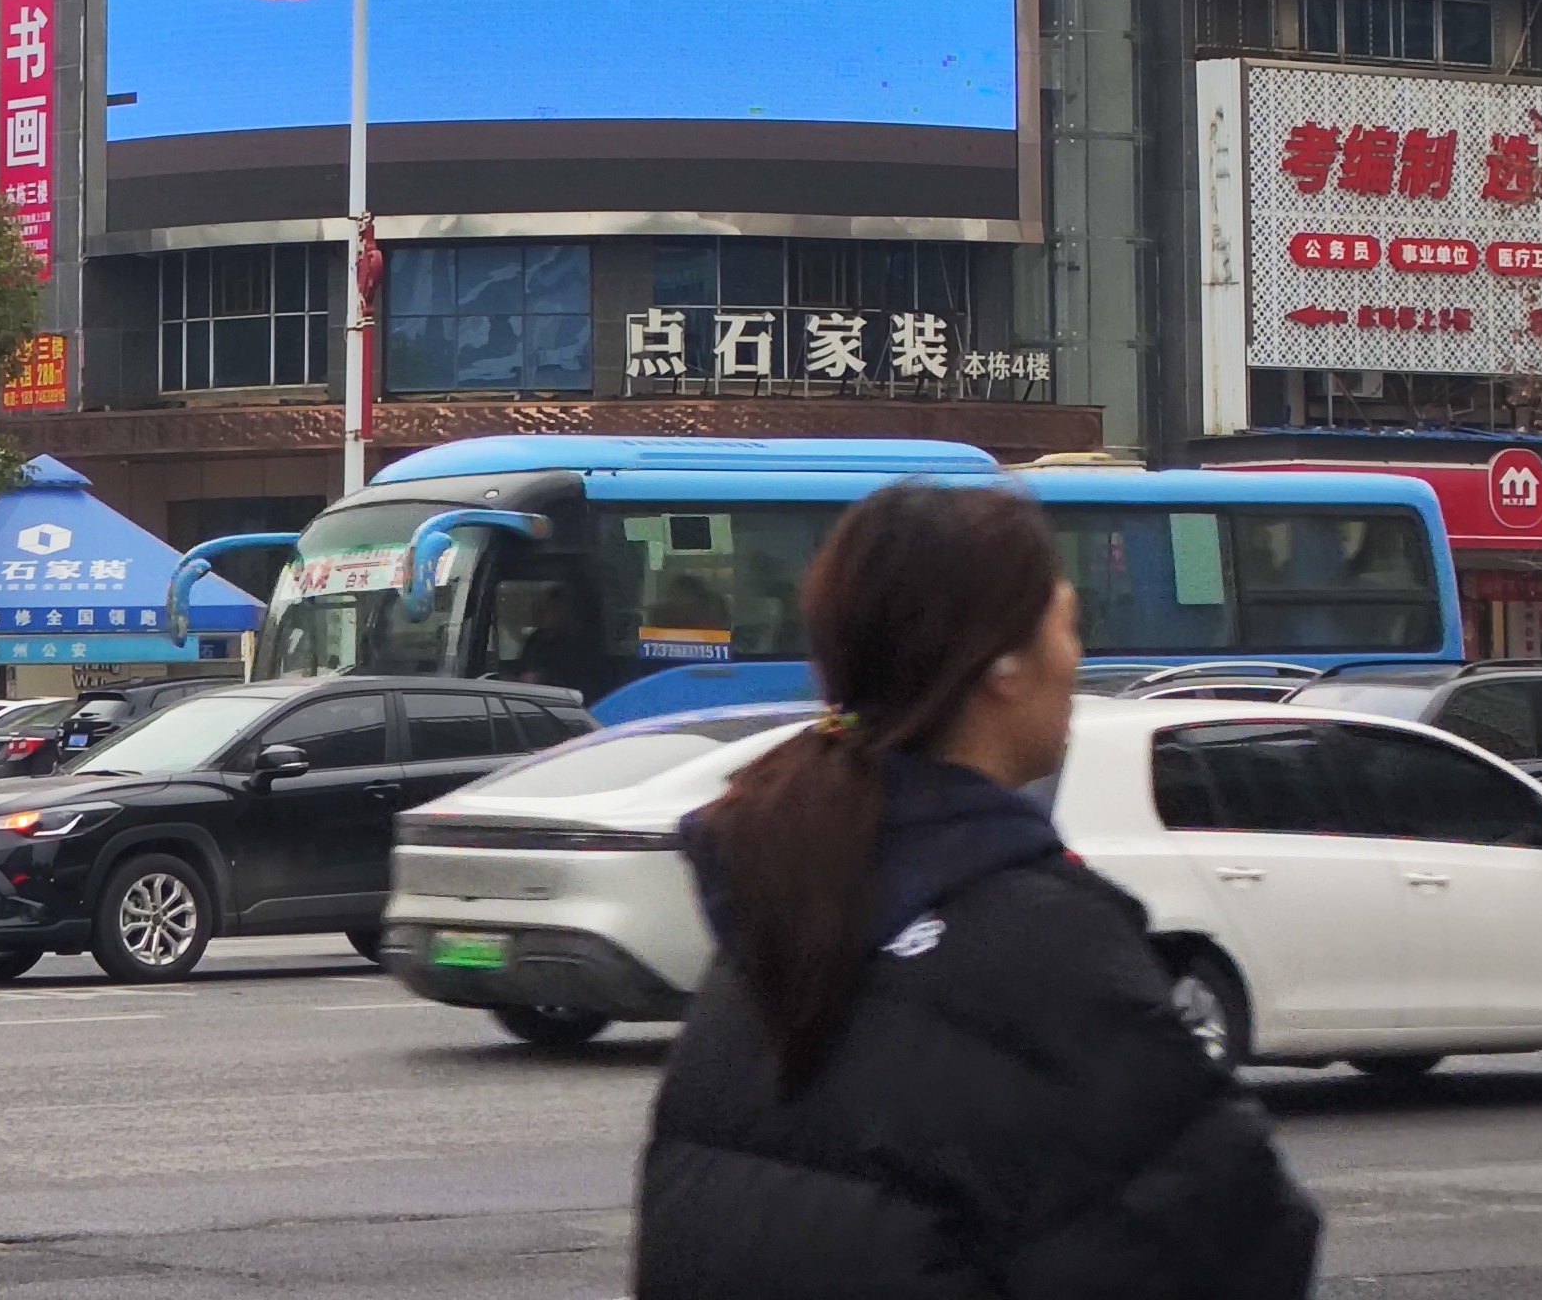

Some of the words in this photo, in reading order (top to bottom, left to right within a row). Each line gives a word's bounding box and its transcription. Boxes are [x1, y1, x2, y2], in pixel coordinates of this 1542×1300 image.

[1281, 120, 1458, 200] 考编制
[1304, 239, 1371, 262] 公务员
[1401, 243, 1469, 266] 事业单位
[626, 308, 949, 379] 点石家装
[964, 350, 1050, 381] 本栋4楼
